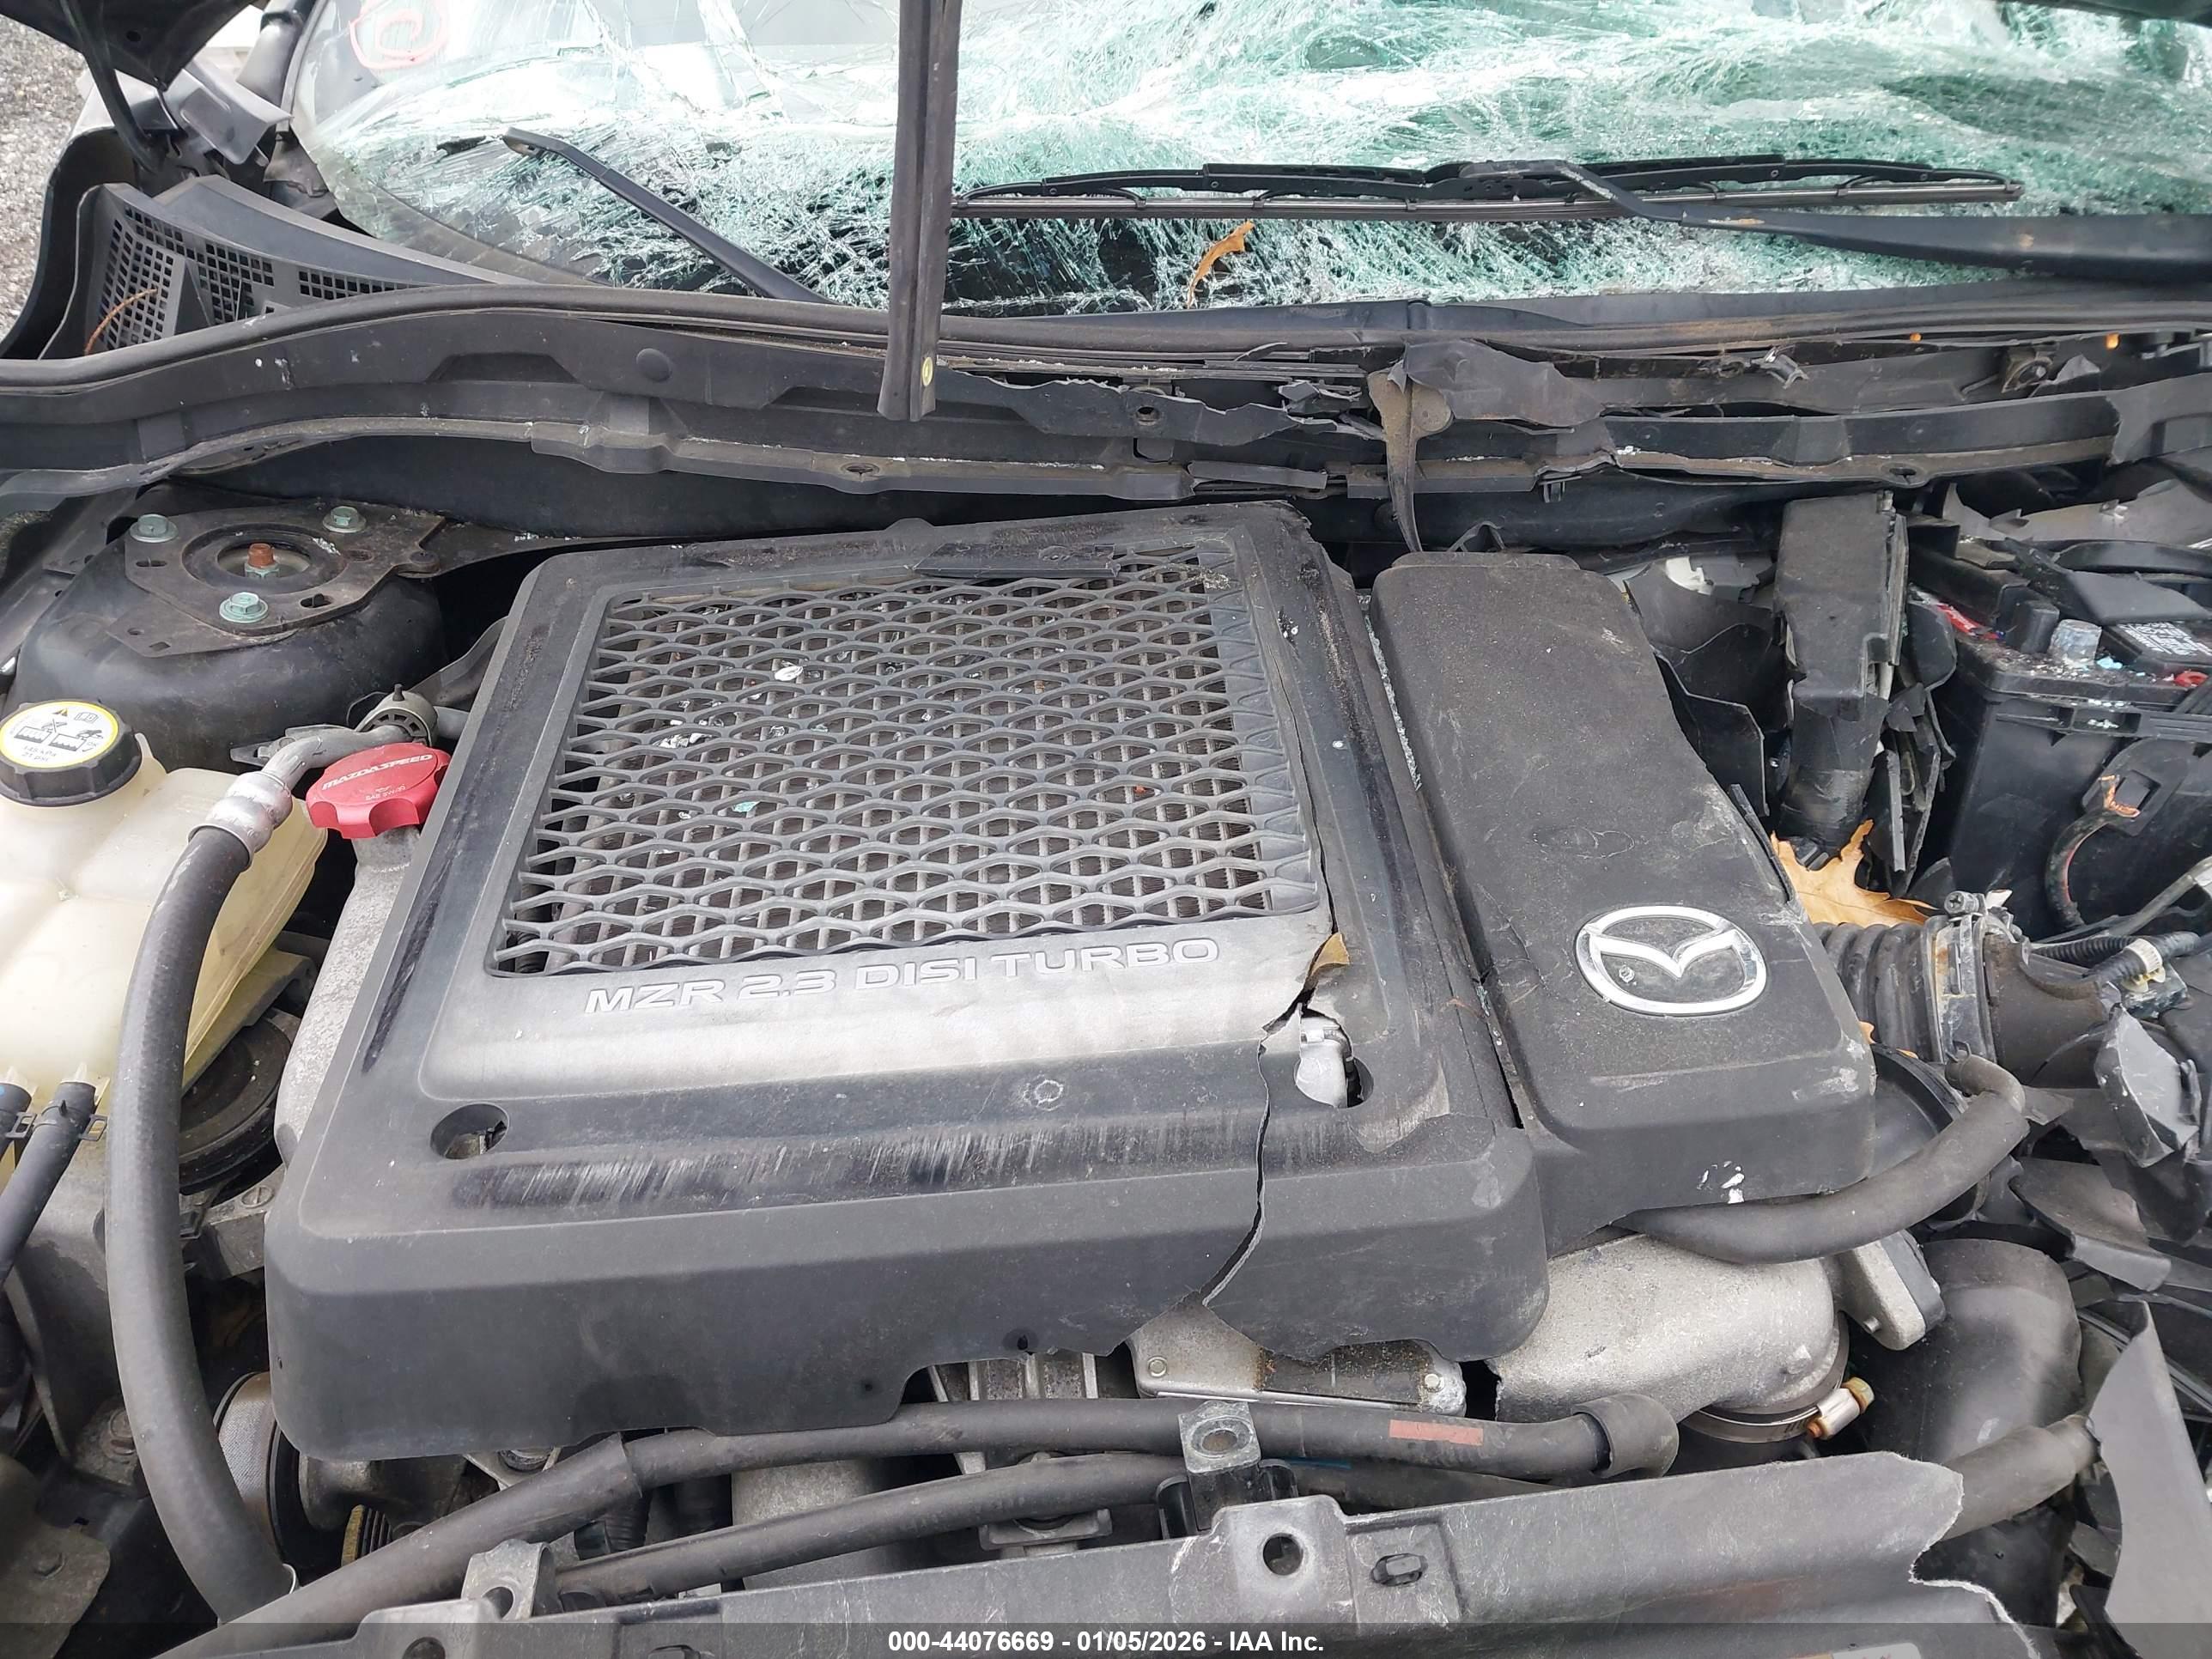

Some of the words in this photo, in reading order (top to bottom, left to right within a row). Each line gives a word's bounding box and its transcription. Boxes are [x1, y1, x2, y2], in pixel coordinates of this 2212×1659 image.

[322, 754, 433, 790] MAZDASPEED
[584, 979, 726, 1014] MZR
[738, 969, 837, 1001] 2.3
[854, 957, 976, 989] DISI
[990, 937, 1219, 977] TURBO
